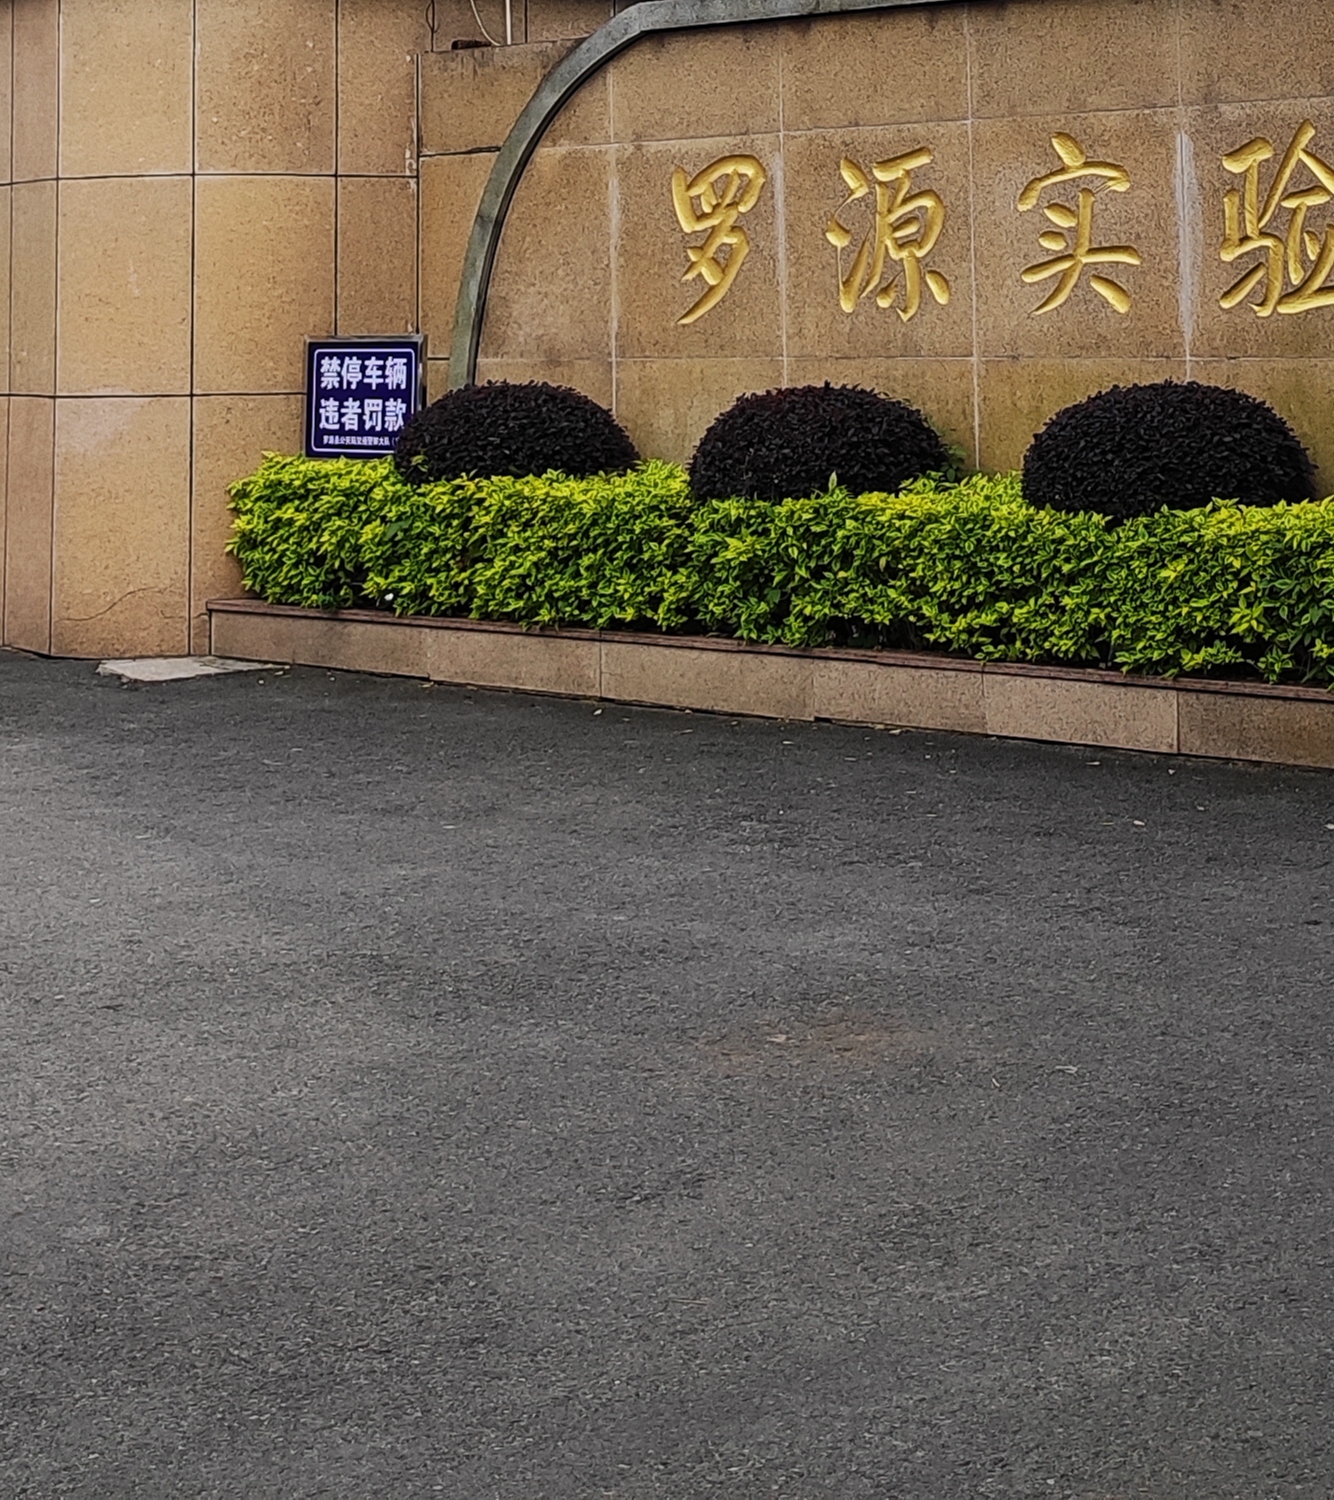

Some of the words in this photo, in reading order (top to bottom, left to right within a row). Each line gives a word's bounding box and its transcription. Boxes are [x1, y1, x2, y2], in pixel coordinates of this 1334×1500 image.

[320, 356, 408, 390] 禁停车辆
[319, 397, 407, 432] 违者罚款
